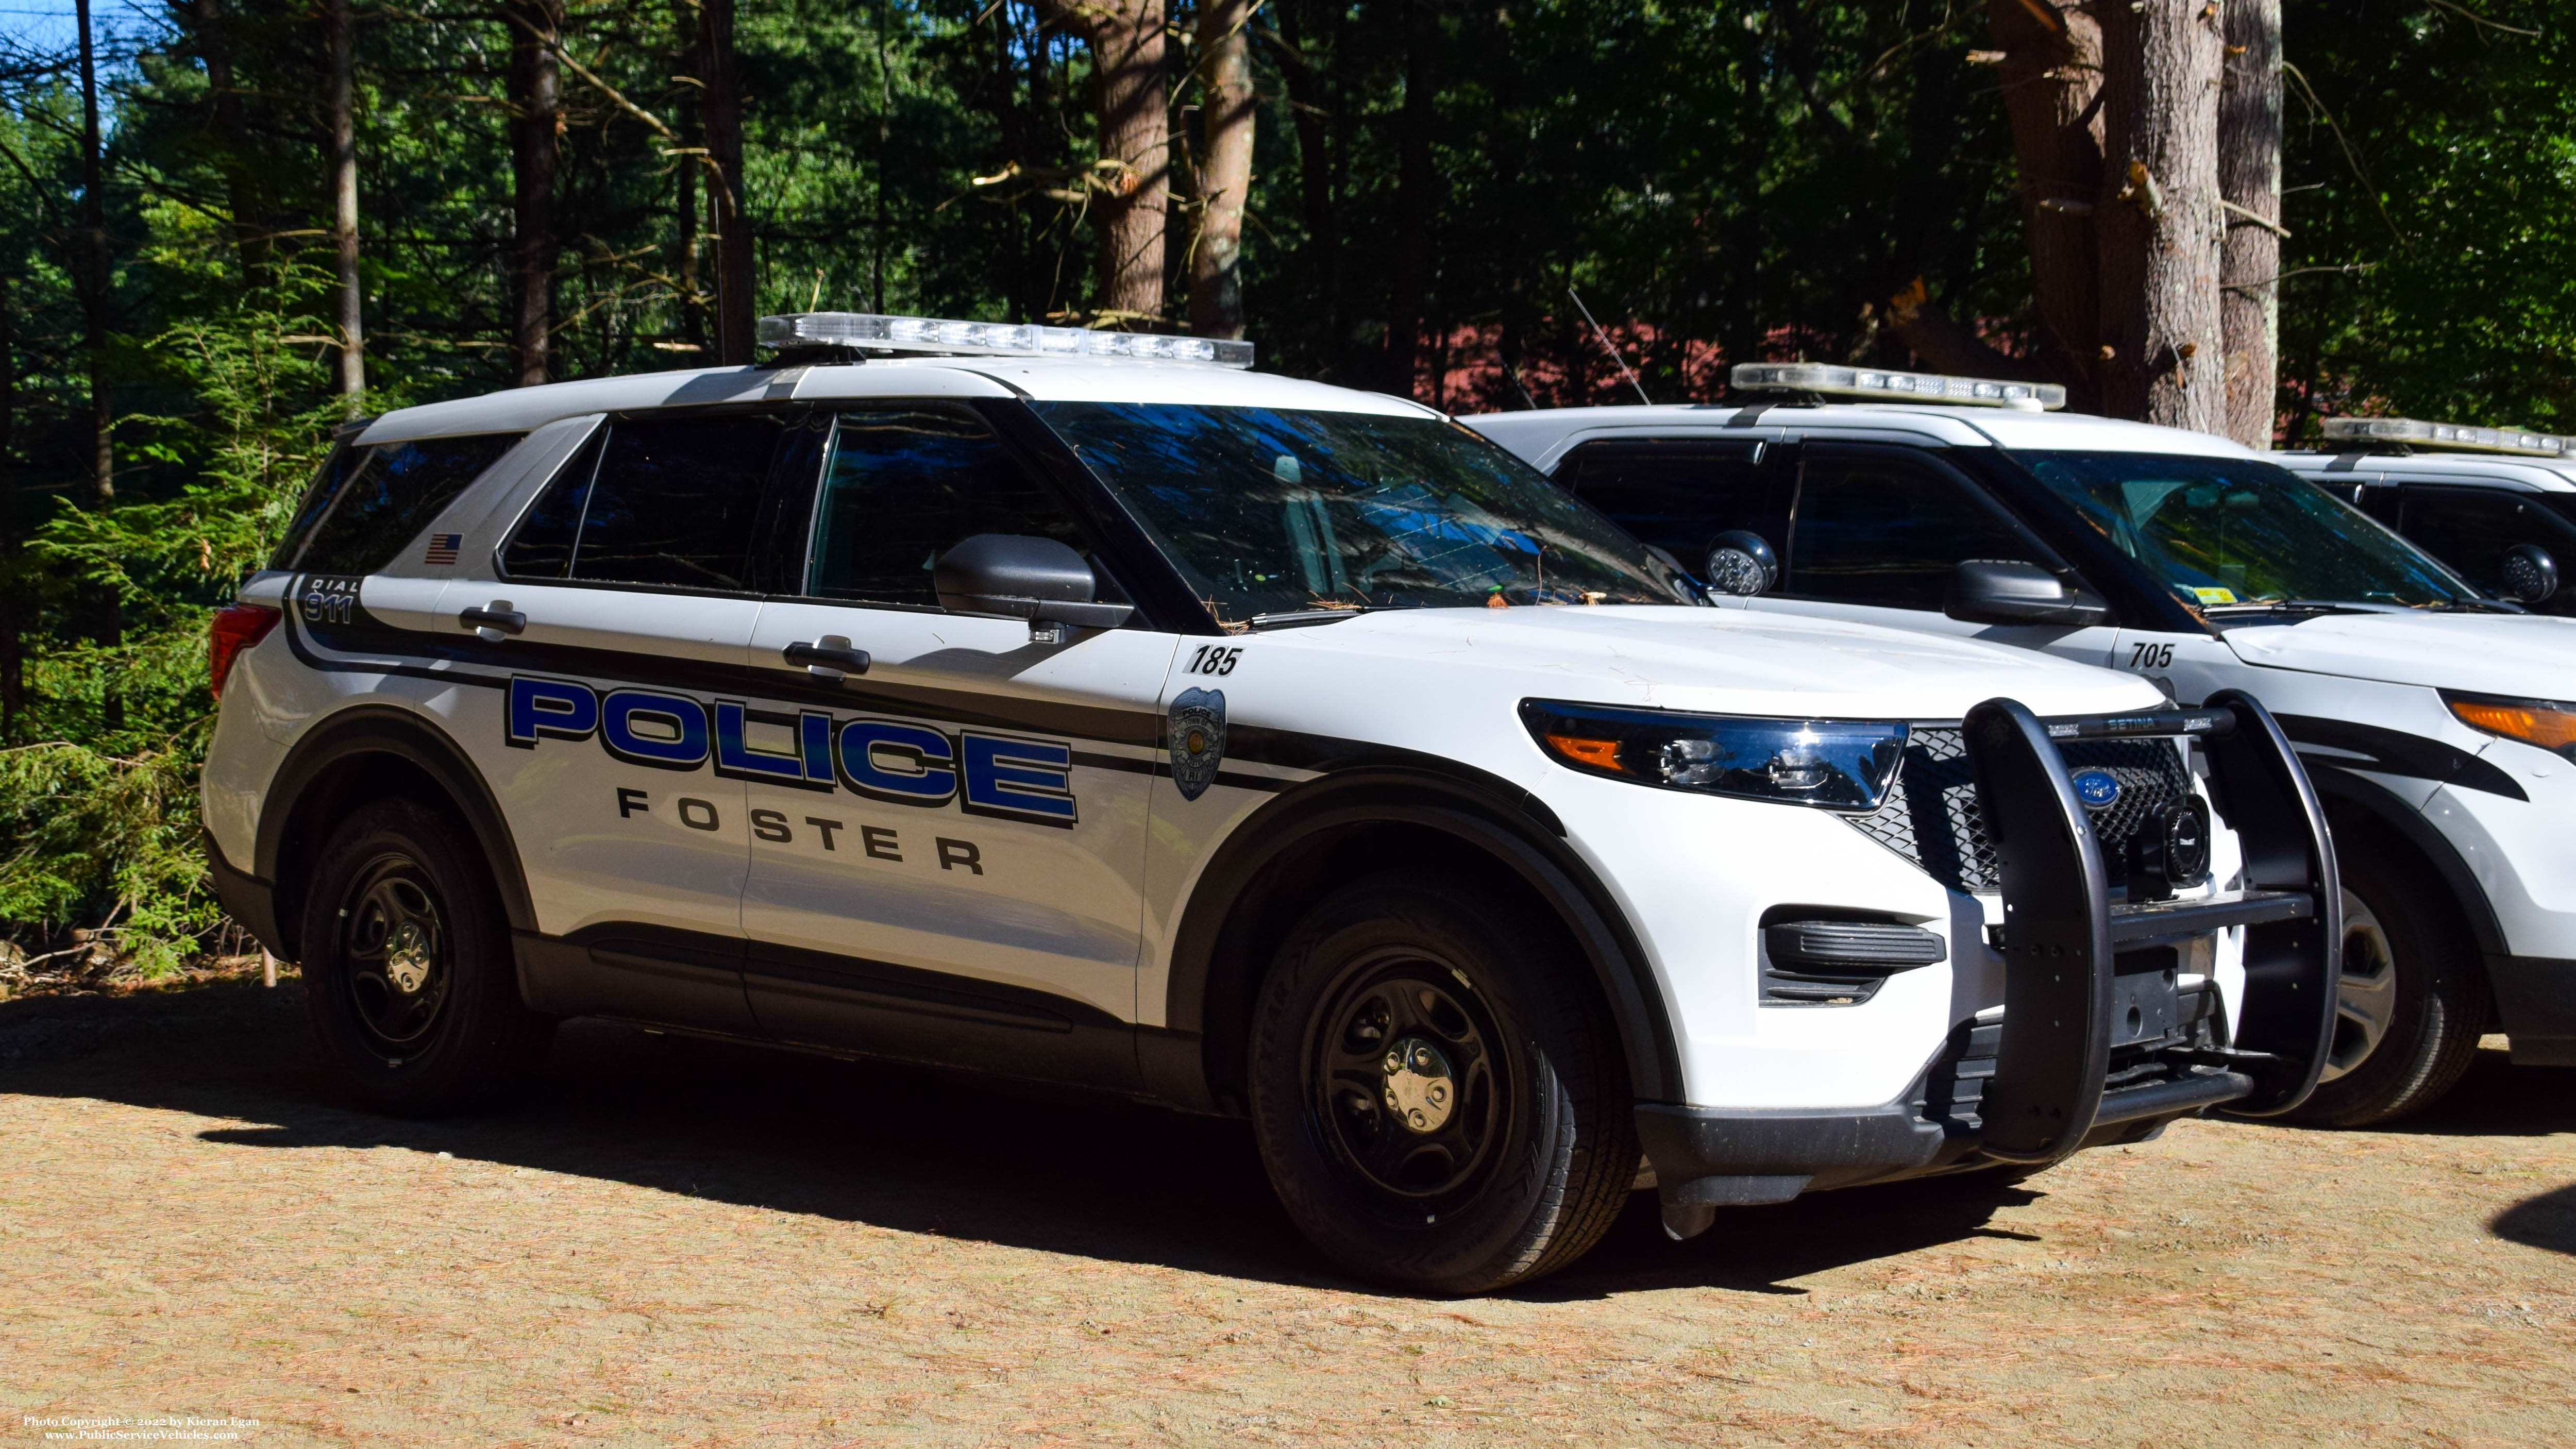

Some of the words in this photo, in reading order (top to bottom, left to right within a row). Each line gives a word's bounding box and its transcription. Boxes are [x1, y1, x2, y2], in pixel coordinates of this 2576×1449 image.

[311, 579, 358, 593] DIAL
[306, 592, 355, 625] 911
[1190, 645, 1243, 676] 185
[2130, 643, 2175, 668] 705
[1183, 708, 1211, 718] POLICE
[1185, 718, 1201, 727] TOWN
[2108, 717, 2155, 731] SETINA
[503, 673, 1078, 830] POLICE
[1189, 772, 1199, 780] RI
[616, 787, 983, 875] FOSTER
